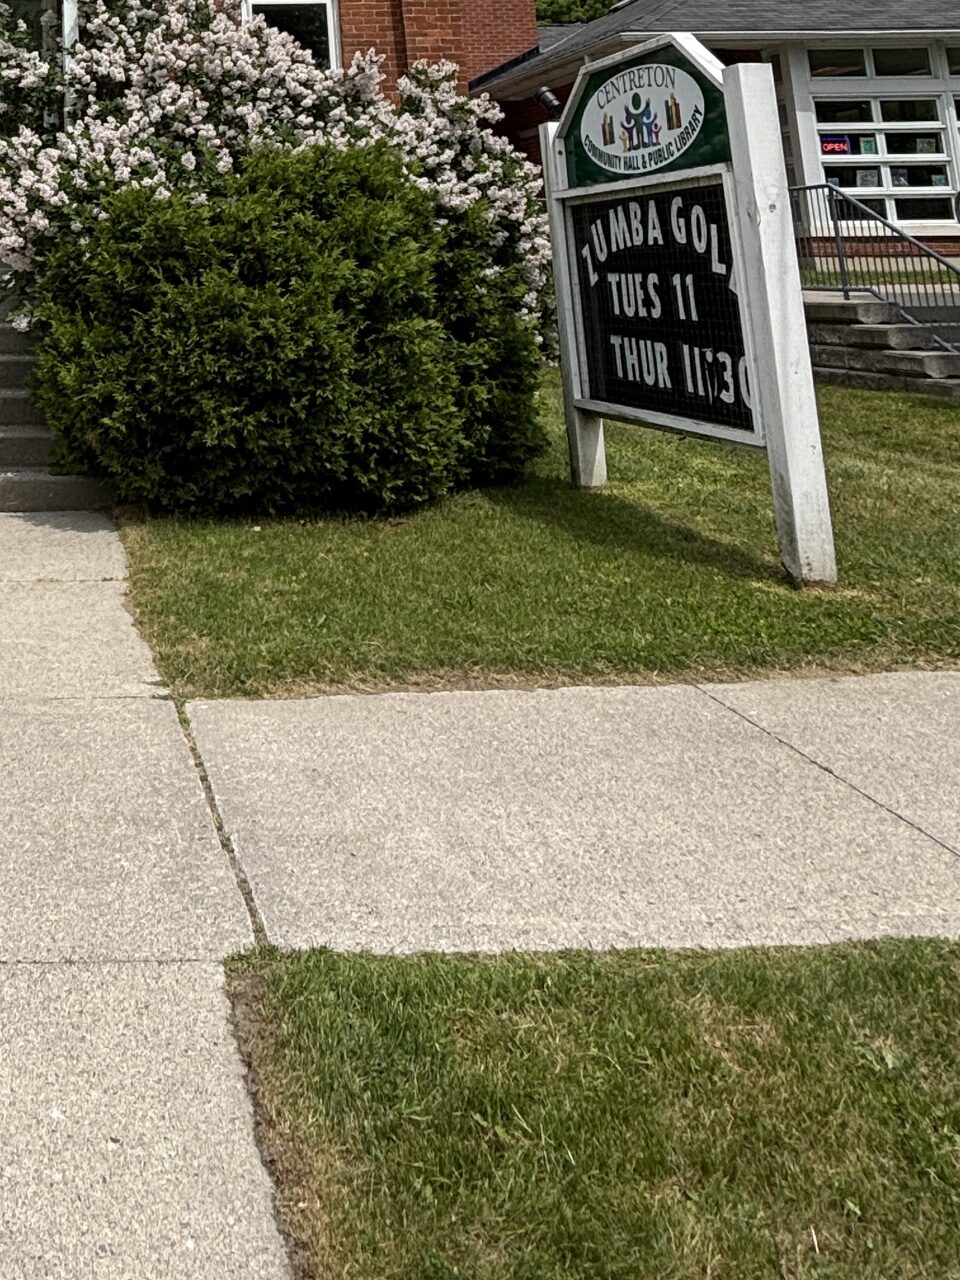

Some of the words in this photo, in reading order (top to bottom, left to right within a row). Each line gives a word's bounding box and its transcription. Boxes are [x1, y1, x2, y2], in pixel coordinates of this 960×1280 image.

[596, 65, 676, 110] CENTRETON
[584, 134, 622, 170] COMMUNITY
[623, 154, 640, 171] HALL
[641, 154, 647, 169] &
[648, 142, 675, 167] PUBLIC
[675, 104, 704, 153] LIBRARY
[822, 142, 848, 152] OPEN
[581, 199, 664, 288] ZUMBA
[670, 196, 732, 285] GOL
[607, 272, 662, 319] TUES
[672, 273, 699, 322] 11
[610, 333, 672, 389] THUR
